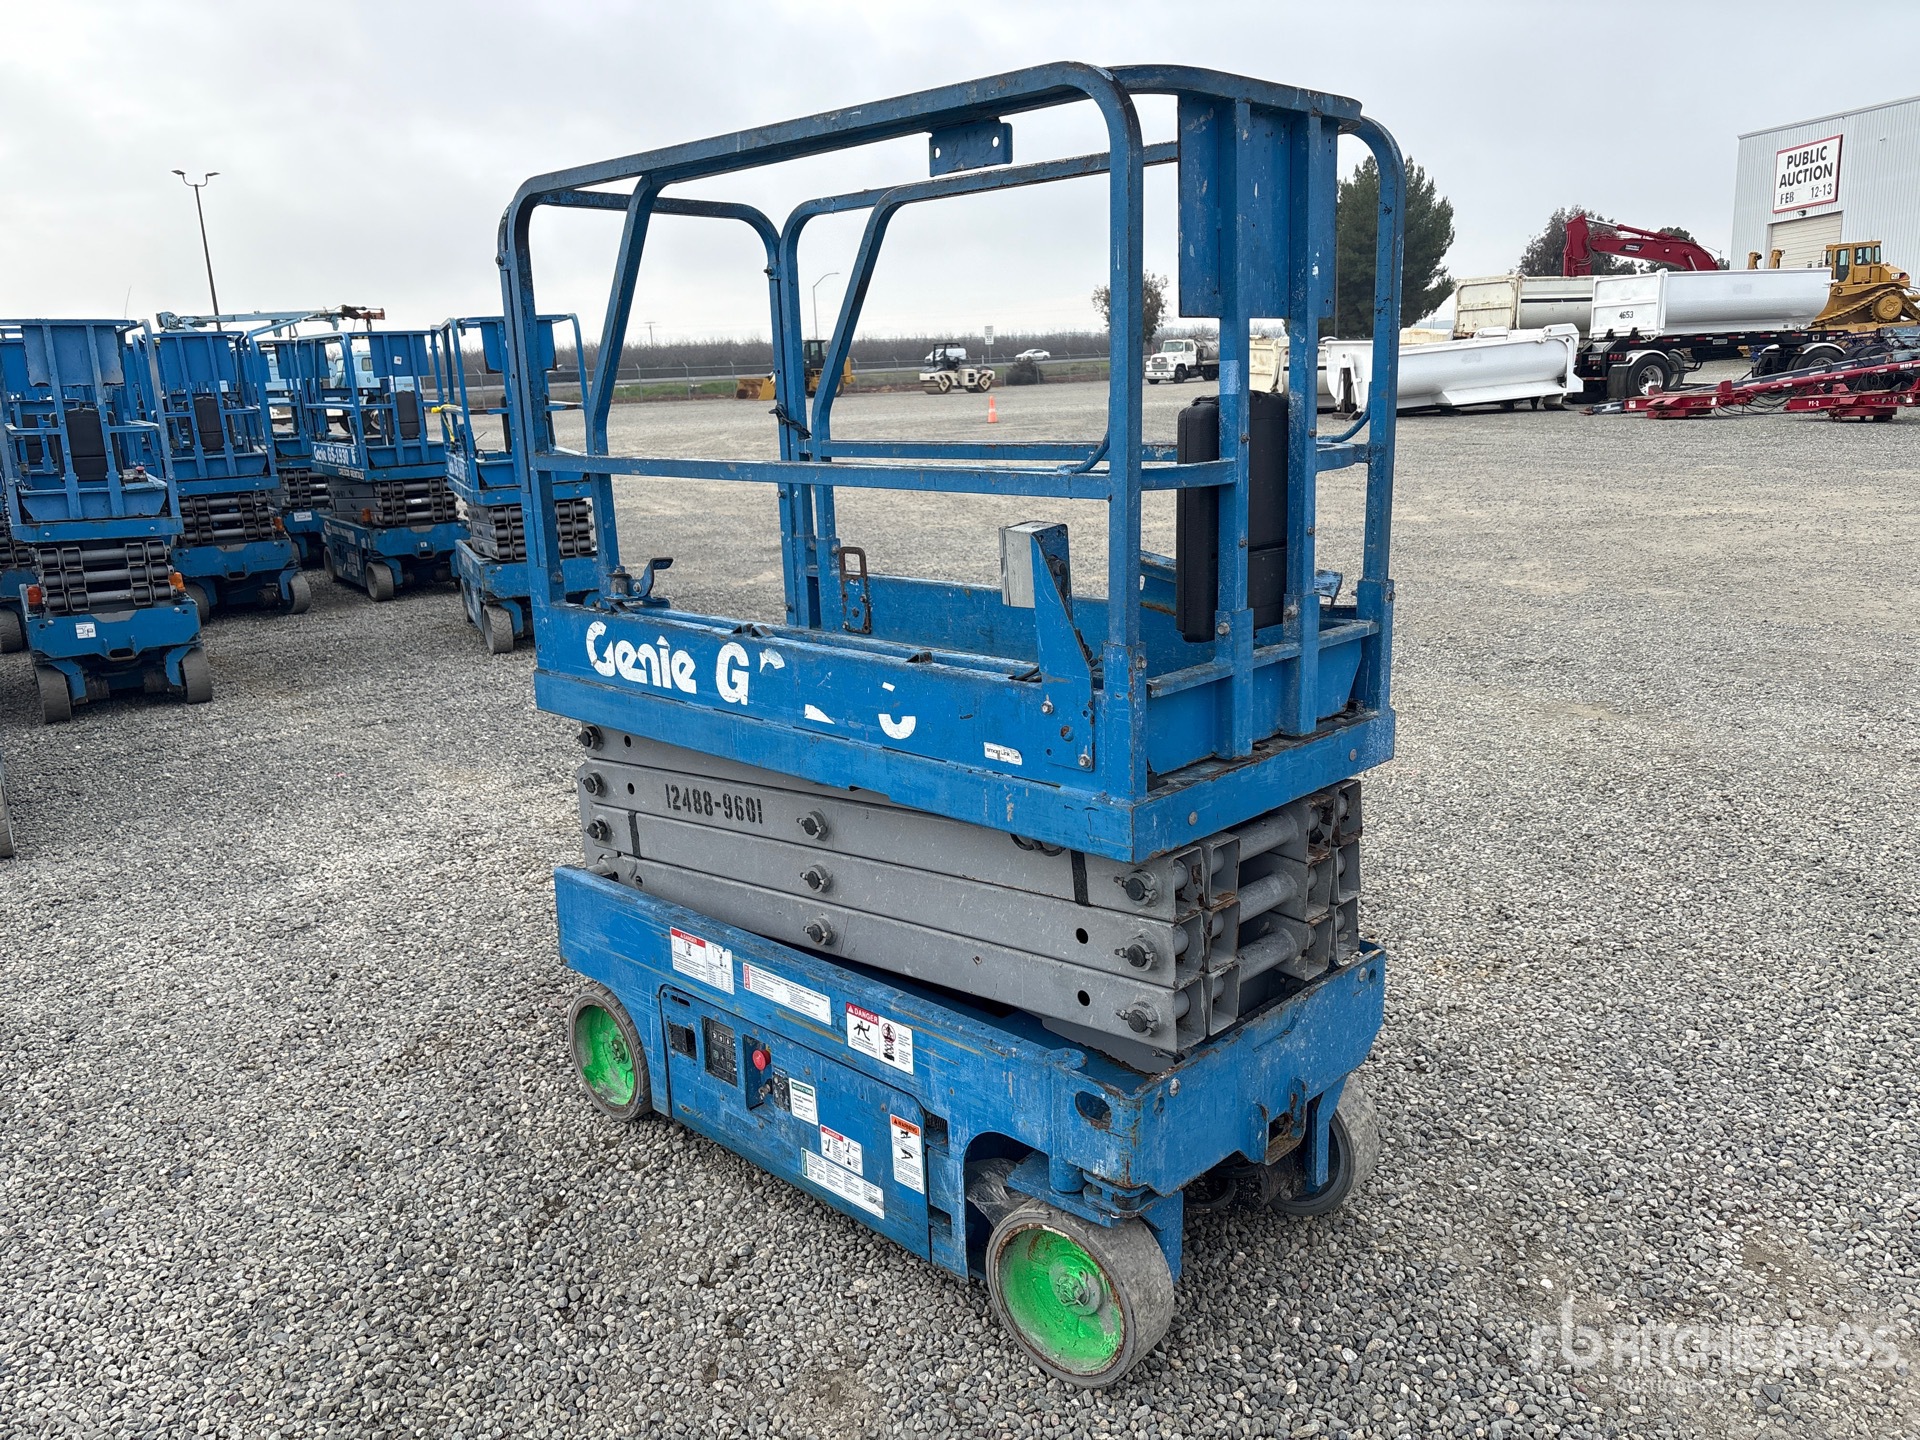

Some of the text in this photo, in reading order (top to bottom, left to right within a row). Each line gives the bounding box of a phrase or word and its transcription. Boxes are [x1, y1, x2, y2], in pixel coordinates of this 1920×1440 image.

[1787, 146, 1827, 169] PUBLIC
[1779, 162, 1833, 188] AUCTION
[1780, 183, 1832, 204] FEB 12-13
[1619, 311, 1633, 319] 4653
[586, 621, 697, 694] Genie
[665, 784, 763, 824] 12488-9601
[854, 1008, 878, 1024] DANGER
